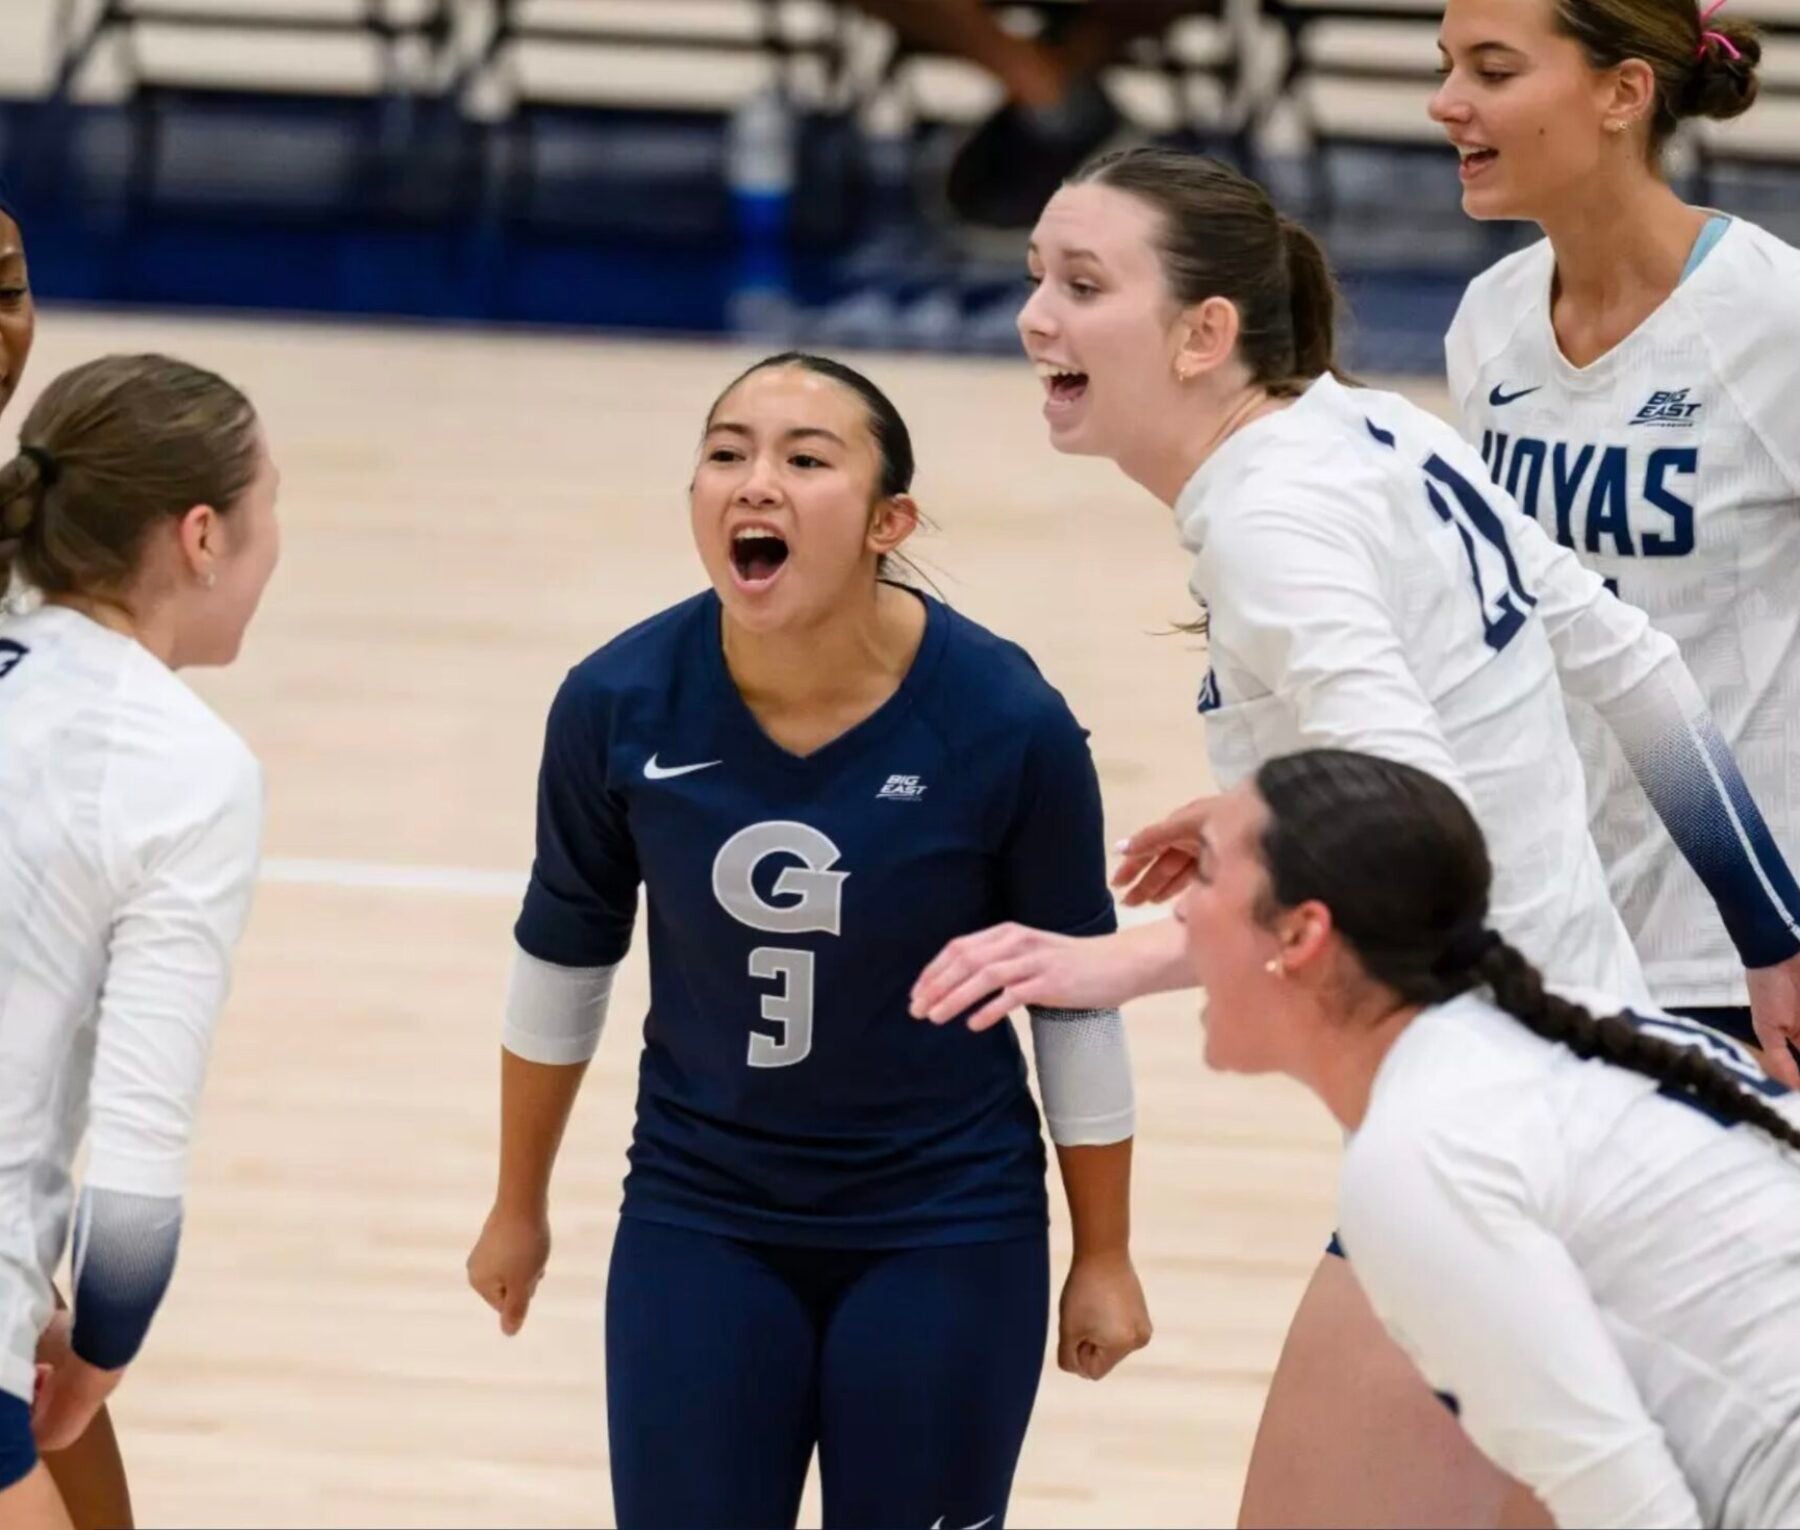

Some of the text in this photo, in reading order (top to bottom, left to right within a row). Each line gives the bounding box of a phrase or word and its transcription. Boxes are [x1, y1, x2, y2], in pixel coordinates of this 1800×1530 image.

[1636, 403, 1702, 418] EAST
[886, 774, 920, 786] BIG
[880, 784, 928, 796] EAST
[712, 820, 852, 937] G
[747, 946, 815, 1068] 3
